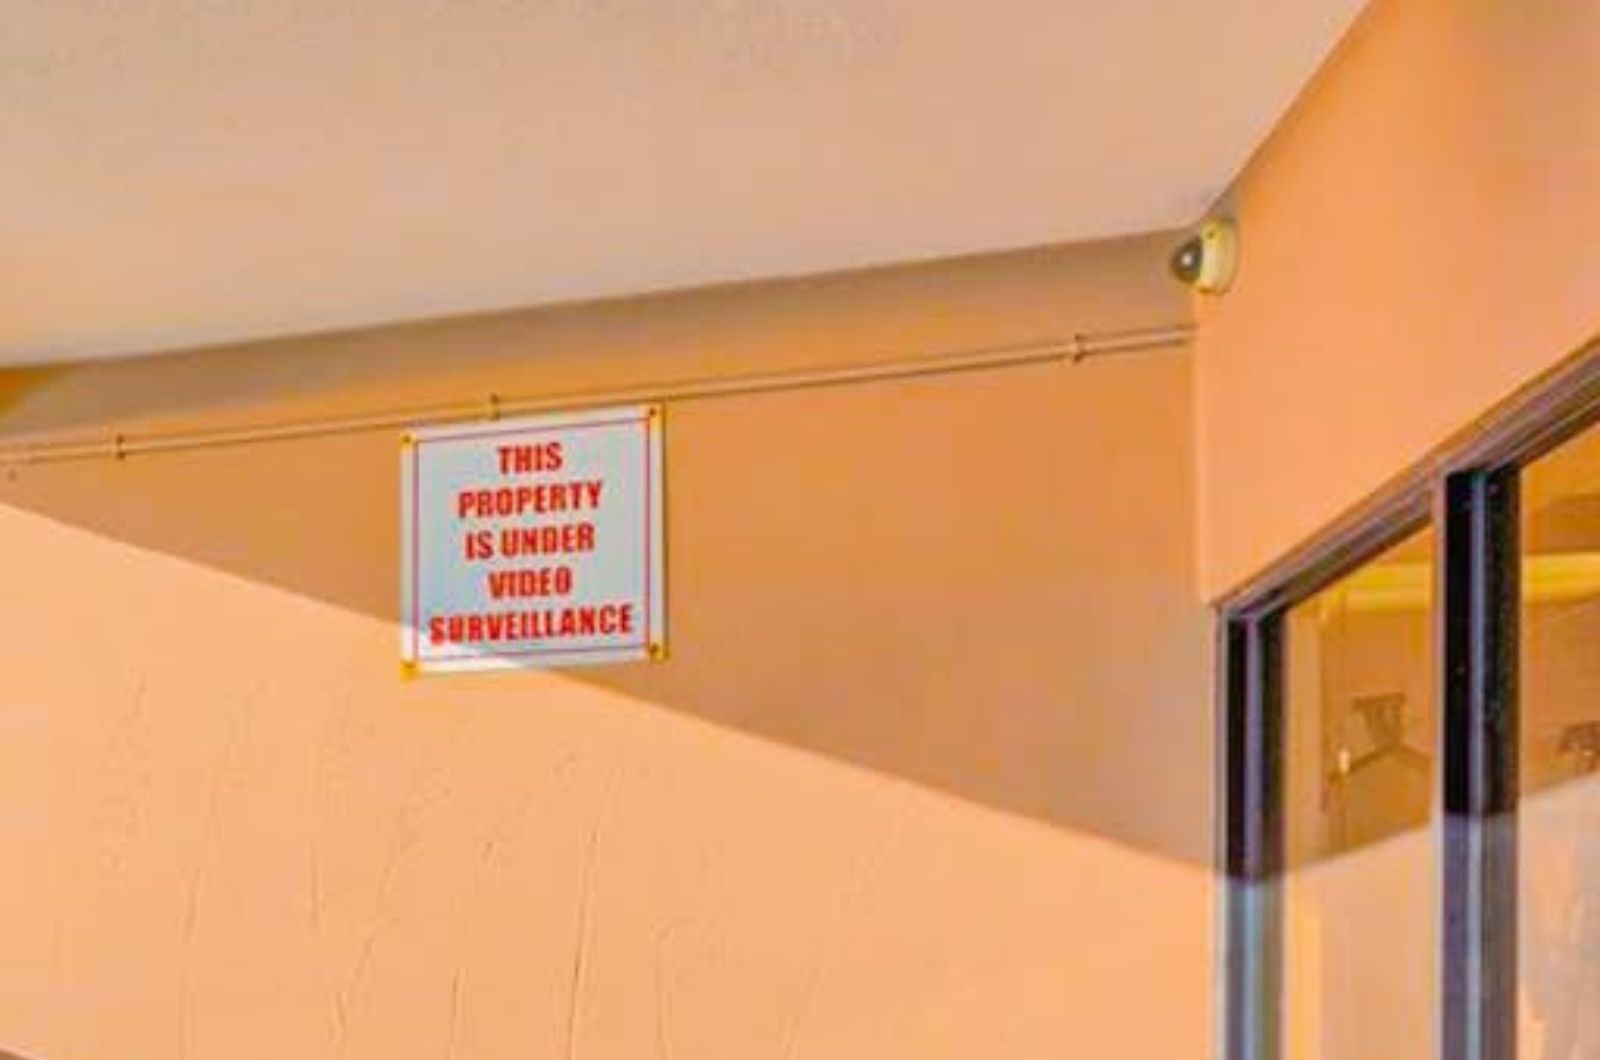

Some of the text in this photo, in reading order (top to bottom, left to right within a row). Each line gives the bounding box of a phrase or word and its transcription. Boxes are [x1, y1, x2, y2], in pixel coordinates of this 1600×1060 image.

[498, 442, 563, 475] THIS
[458, 480, 603, 519] PROPERTY
[464, 523, 595, 560] IS UNDER
[487, 566, 573, 600] VIDEO
[428, 604, 634, 646] SURVEILLANCE
